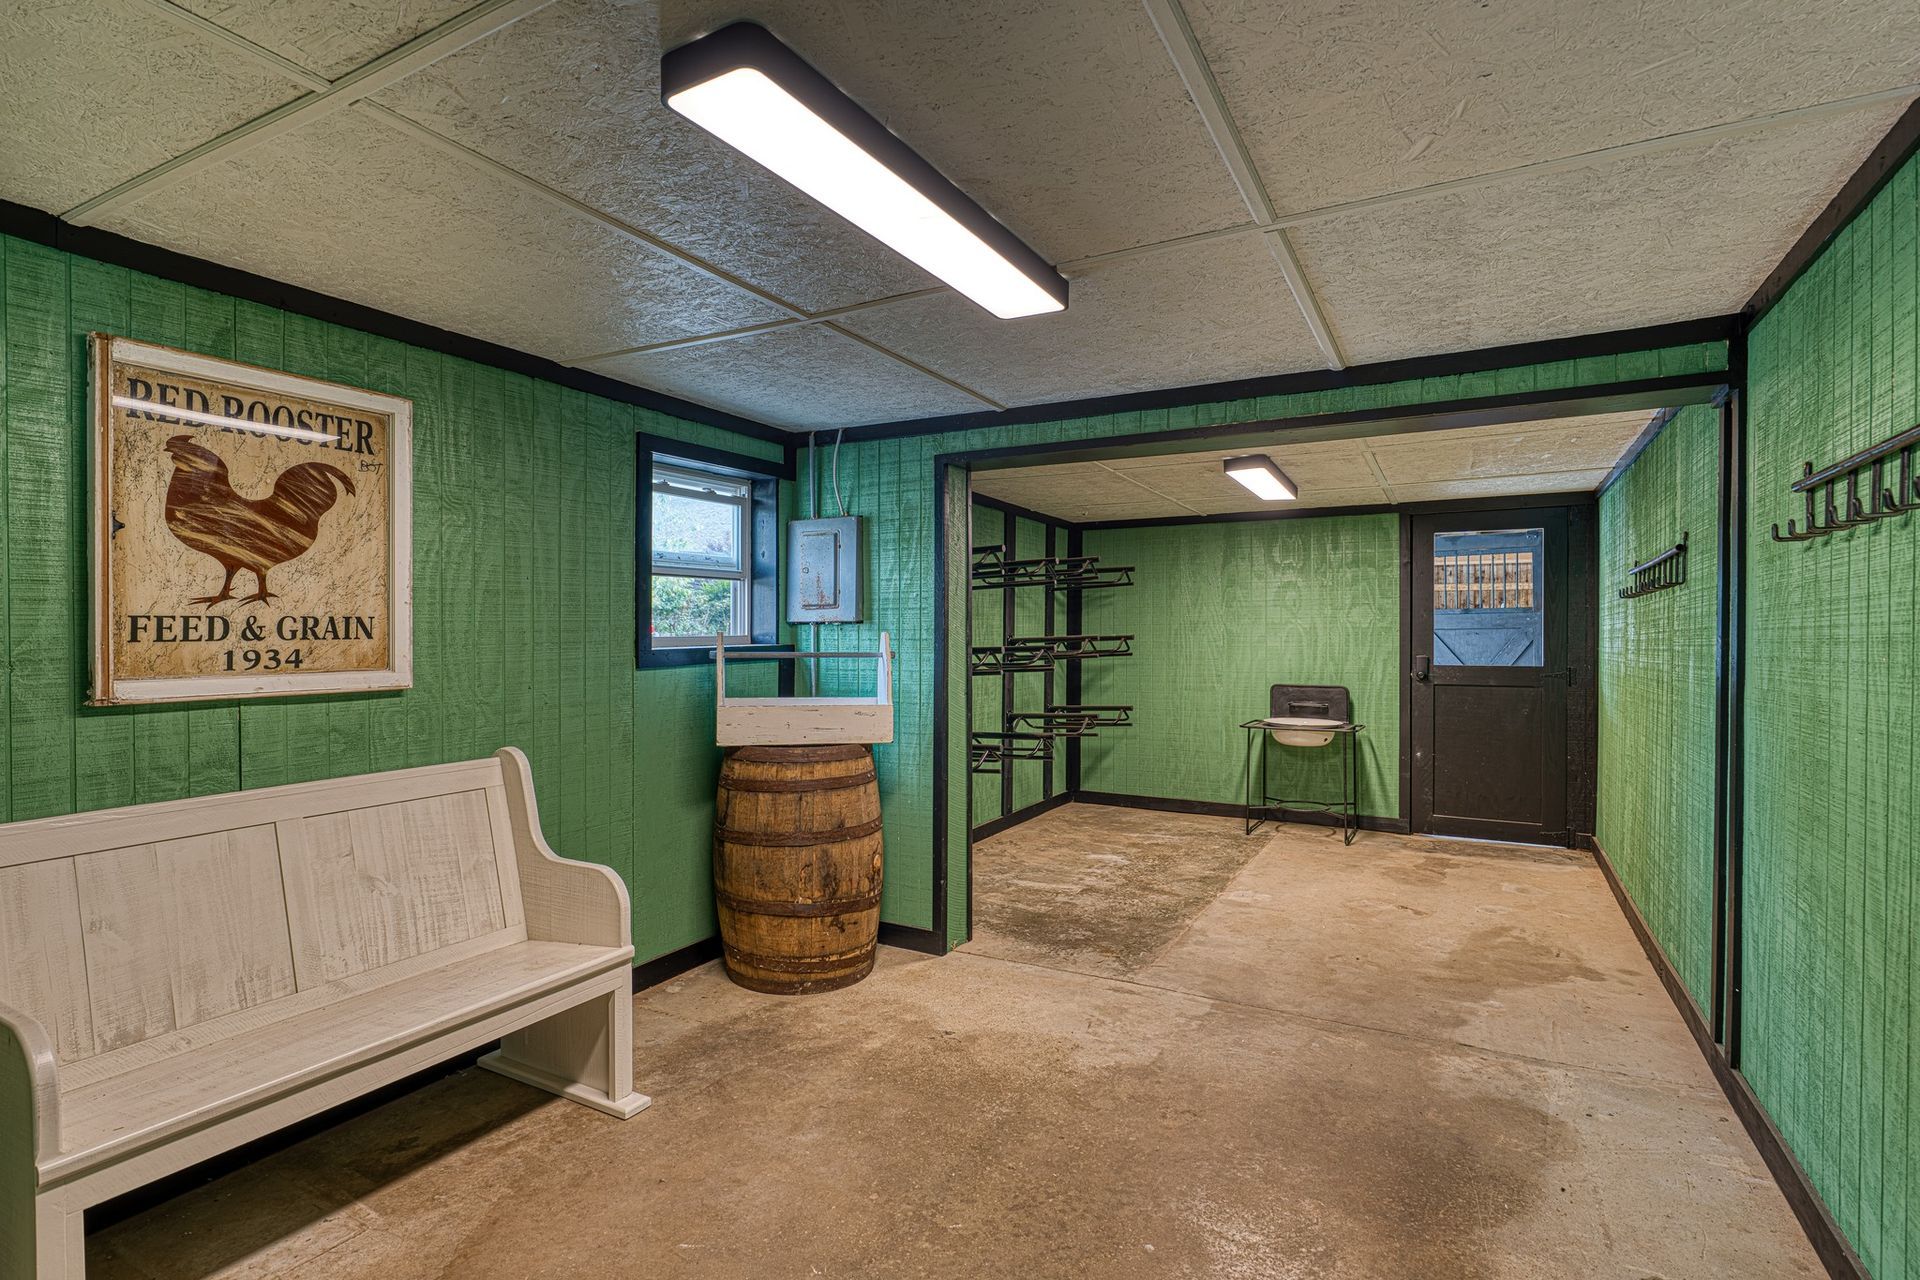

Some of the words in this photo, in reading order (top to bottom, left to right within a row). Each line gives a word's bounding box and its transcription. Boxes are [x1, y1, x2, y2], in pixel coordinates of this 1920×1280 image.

[126, 377, 210, 428] RED
[221, 394, 375, 456] ROOSTER
[127, 614, 230, 643] FEED
[241, 615, 266, 642] &
[276, 615, 375, 641] GRAIN
[223, 648, 303, 672] 1934
